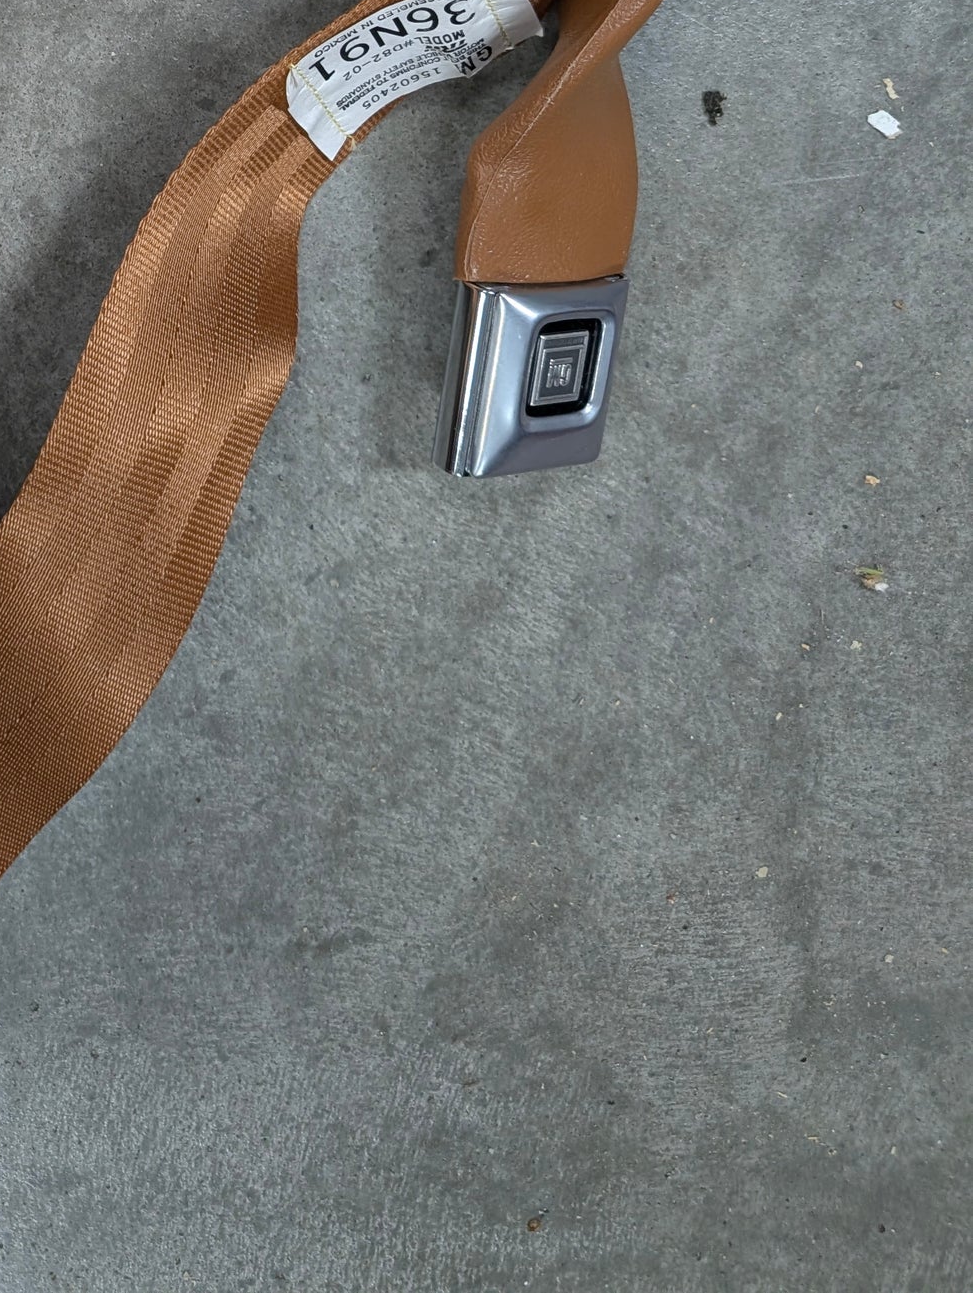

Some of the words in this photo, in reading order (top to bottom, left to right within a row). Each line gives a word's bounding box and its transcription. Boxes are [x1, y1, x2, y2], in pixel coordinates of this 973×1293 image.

[360, 20, 374, 30] IN
[314, 28, 358, 58] MEXICO
[414, 29, 466, 45] MODEL
[454, 37, 485, 57] MOTOR
[467, 42, 487, 56] THIS
[383, 58, 414, 76] SAFETY
[390, 56, 441, 79] CONFORMS
[454, 45, 493, 75] GM
[336, 73, 382, 108] STANDARDS
[362, 67, 442, 110] 15602405
[376, 77, 390, 87] TO
[339, 84, 376, 111] FEDERAL
